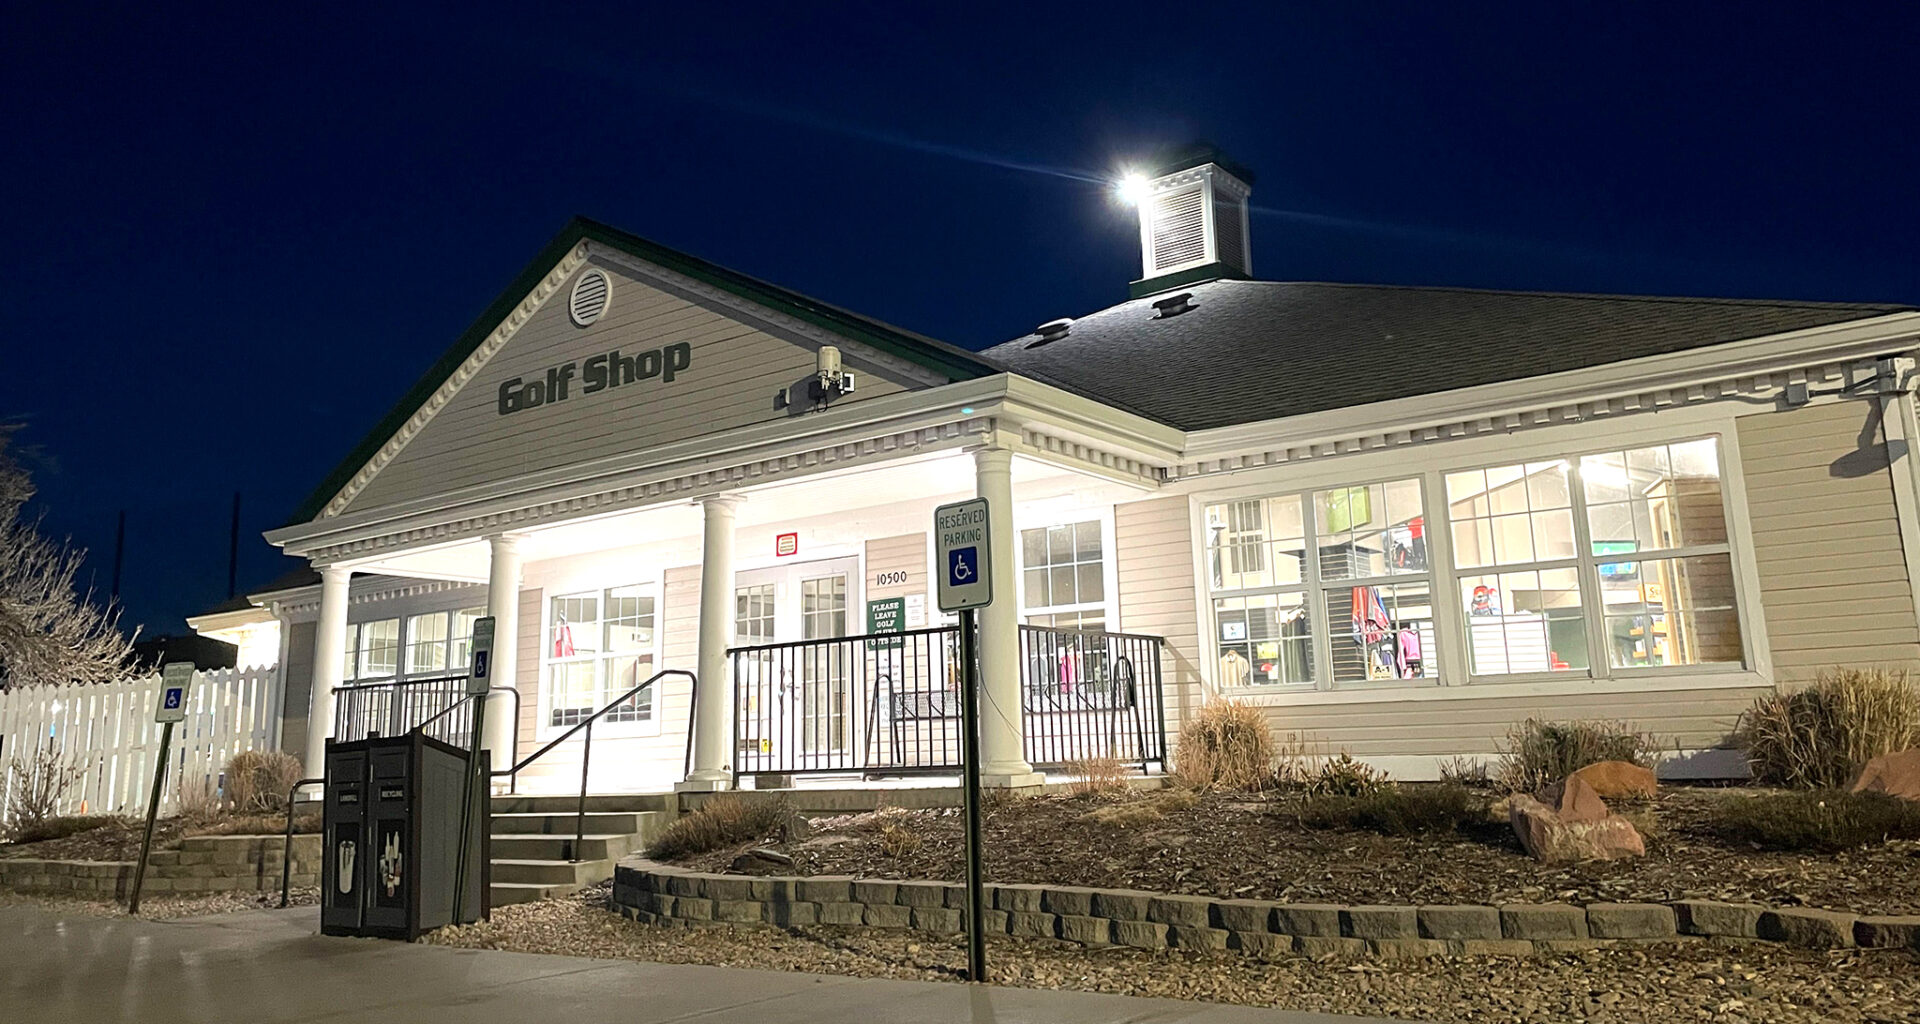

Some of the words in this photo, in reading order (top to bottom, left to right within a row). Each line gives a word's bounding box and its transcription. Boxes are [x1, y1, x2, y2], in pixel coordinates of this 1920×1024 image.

[498, 362, 576, 415] Golf
[583, 342, 691, 394] Shop
[939, 509, 985, 530] RESERVED
[944, 528, 981, 547] PARKING
[876, 571, 907, 585] 10500
[872, 602, 899, 612] PLEASE
[874, 611, 897, 620] LEAVE
[876, 620, 895, 628] GOLF
[871, 636, 902, 646] OTSDE
